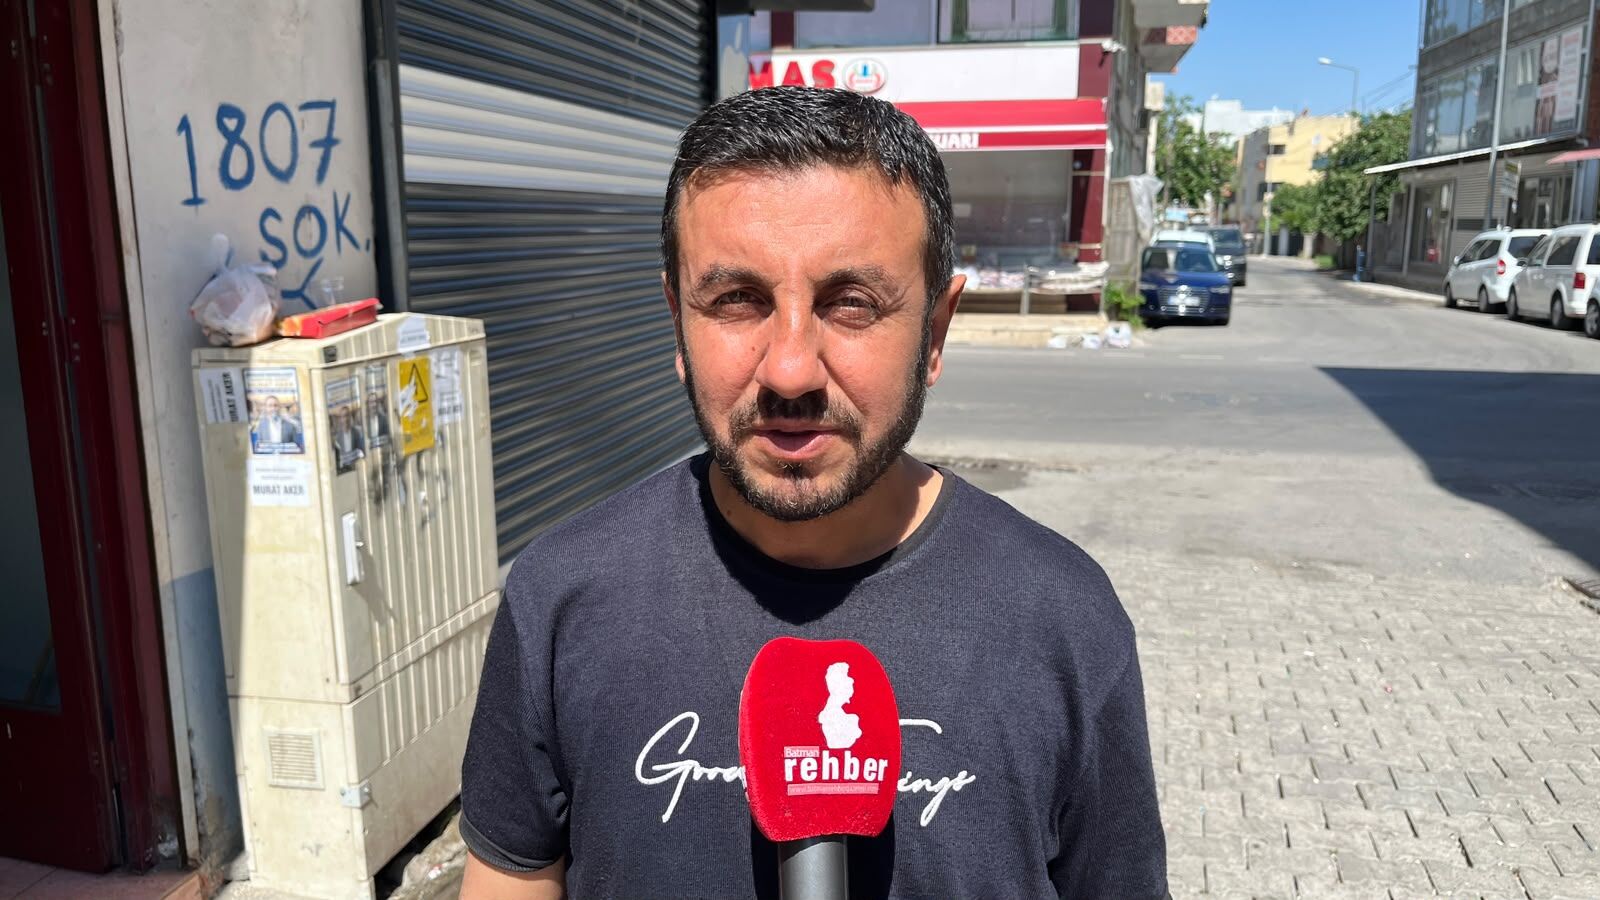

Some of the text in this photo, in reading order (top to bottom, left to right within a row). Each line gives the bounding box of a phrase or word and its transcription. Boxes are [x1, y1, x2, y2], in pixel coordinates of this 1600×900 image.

[930, 133, 979, 149] UARI
[177, 98, 341, 205] 1807
[253, 484, 305, 496] MURAT AKER
[785, 748, 819, 757] Batman
[784, 750, 888, 781] rehber
